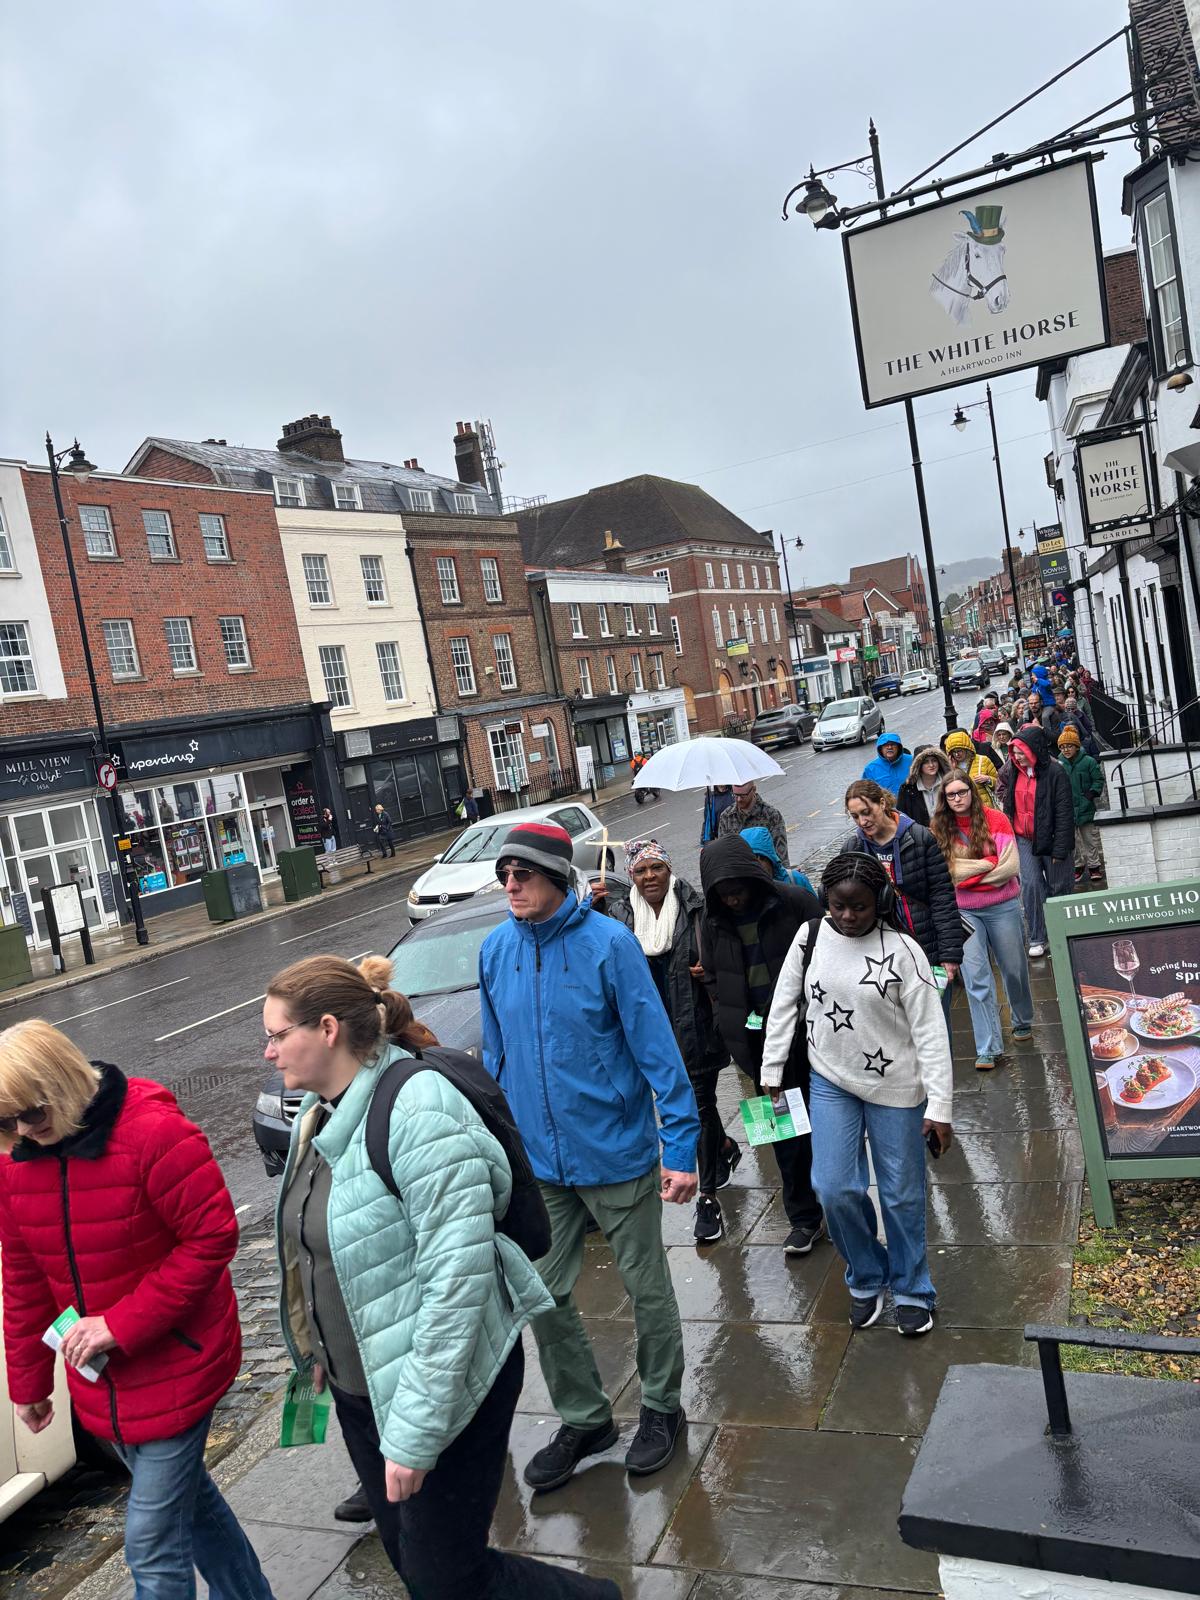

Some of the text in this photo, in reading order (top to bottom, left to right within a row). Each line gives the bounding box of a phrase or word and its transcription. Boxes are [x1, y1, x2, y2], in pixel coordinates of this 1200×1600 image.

[883, 309, 1080, 376] THE WHITE HORSE
[940, 349, 1023, 377] A HEARTWOOD INN
[1105, 460, 1120, 468] THE
[1089, 465, 1138, 484] WHITE
[1090, 478, 1141, 498] HORSE
[1102, 528, 1140, 540] GARDEN
[1051, 539, 1062, 547] Let
[1043, 565, 1068, 575] DOWNS
[5, 755, 71, 775] MILL VIEW
[291, 795, 315, 806] order &
[1063, 902, 1098, 919] THE
[1103, 894, 1164, 914] WHITE
[1117, 910, 1175, 923] HEARTWOOD
[1177, 907, 1195, 916] INN
[1149, 960, 1198, 975] Spring has
[299, 1382, 317, 1401] life
